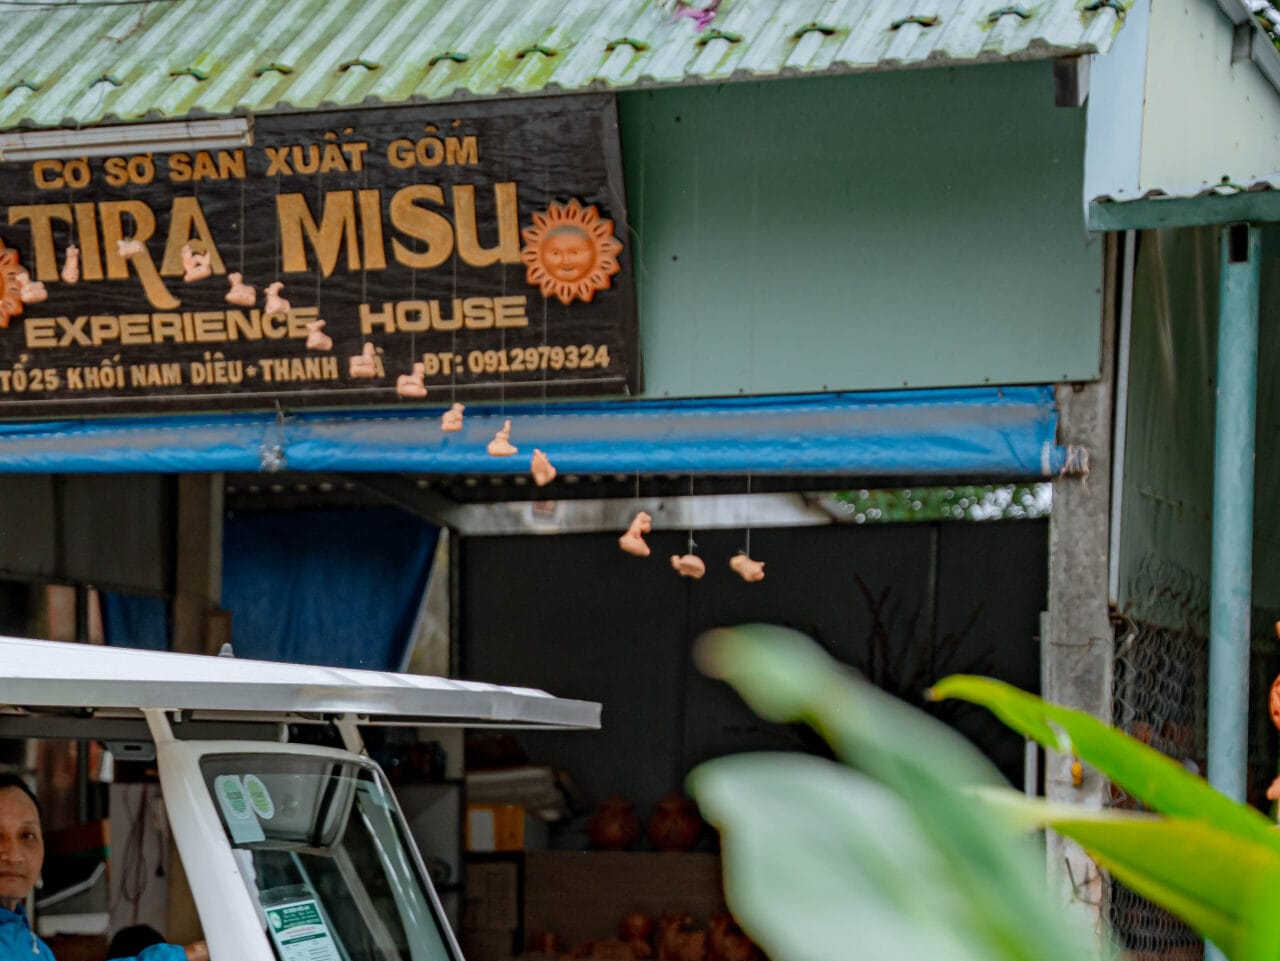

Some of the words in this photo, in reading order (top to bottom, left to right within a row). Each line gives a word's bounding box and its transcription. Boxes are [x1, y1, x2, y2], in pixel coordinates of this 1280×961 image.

[264, 127, 369, 177] XUẤT
[387, 118, 480, 170] GỐM
[7, 196, 227, 310] TIRA
[276, 181, 521, 278] MISU
[24, 307, 320, 349] EXPERIENCE
[359, 295, 529, 334] HOUSE
[130, 362, 182, 388] NAM
[258, 356, 339, 384] THANH
[467, 344, 611, 375] 0912979324
